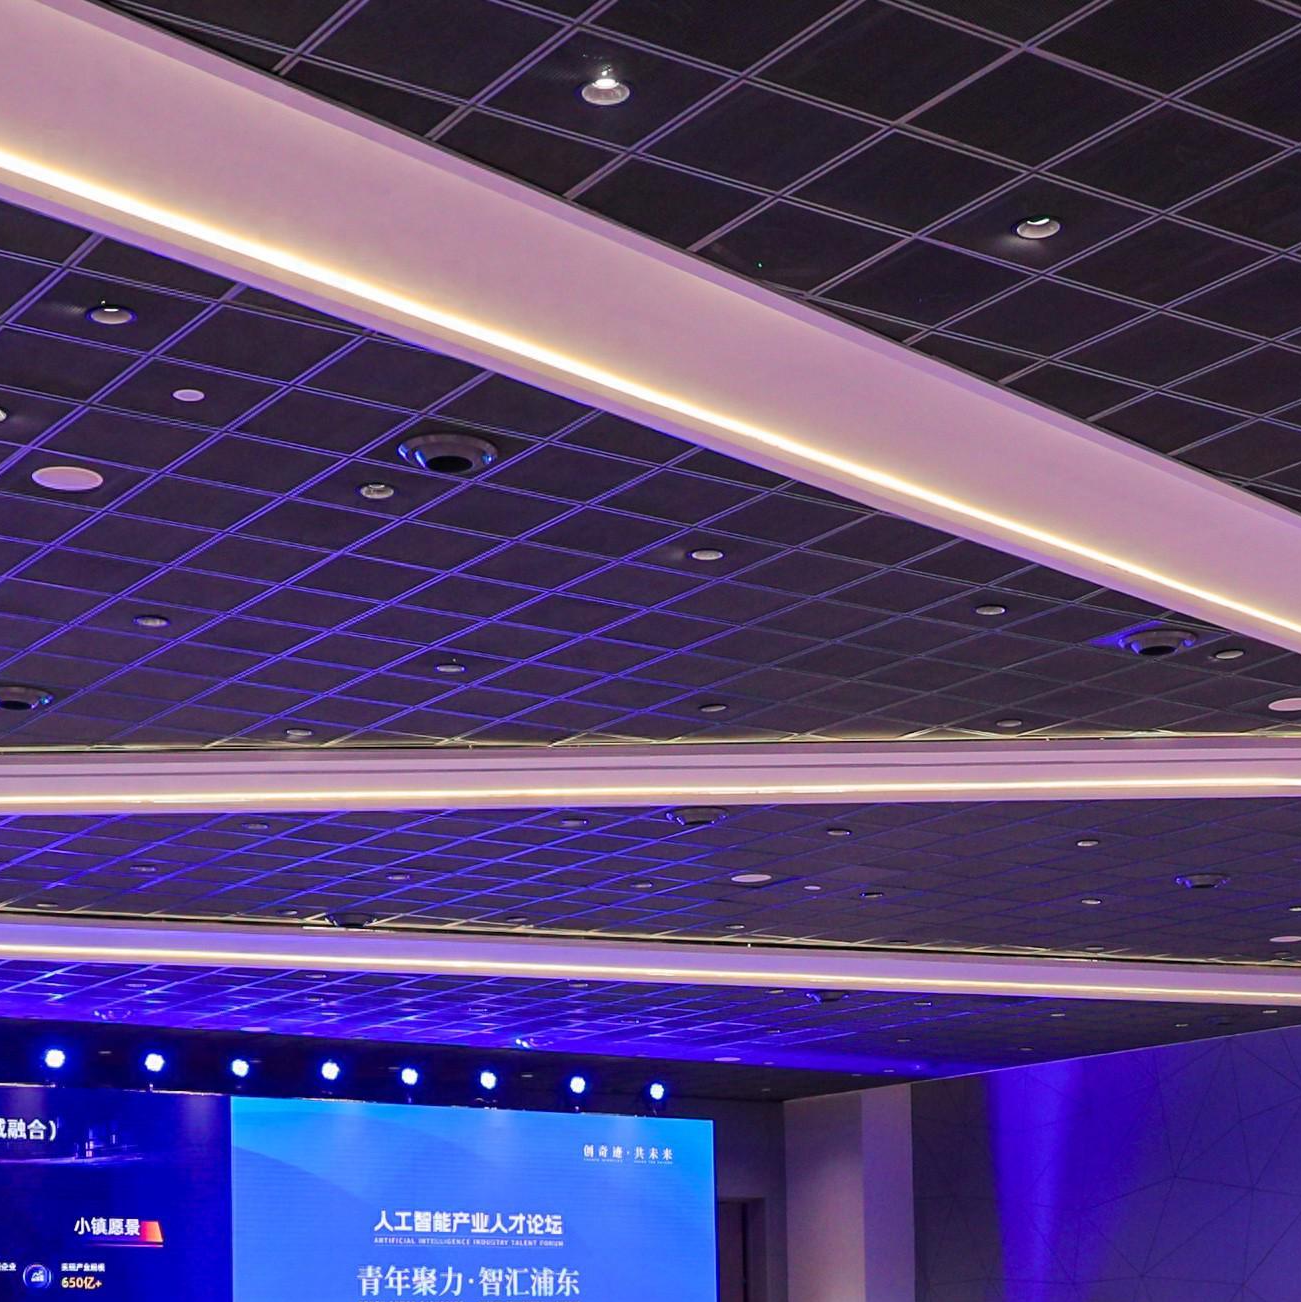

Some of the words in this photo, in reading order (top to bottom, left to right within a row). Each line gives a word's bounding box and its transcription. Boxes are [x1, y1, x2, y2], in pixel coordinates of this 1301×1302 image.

[74, 1217, 140, 1236] 小镇愿景
[374, 1210, 563, 1235] 人工智能产业人才论坛
[61, 1276, 102, 1290] 650亿+
